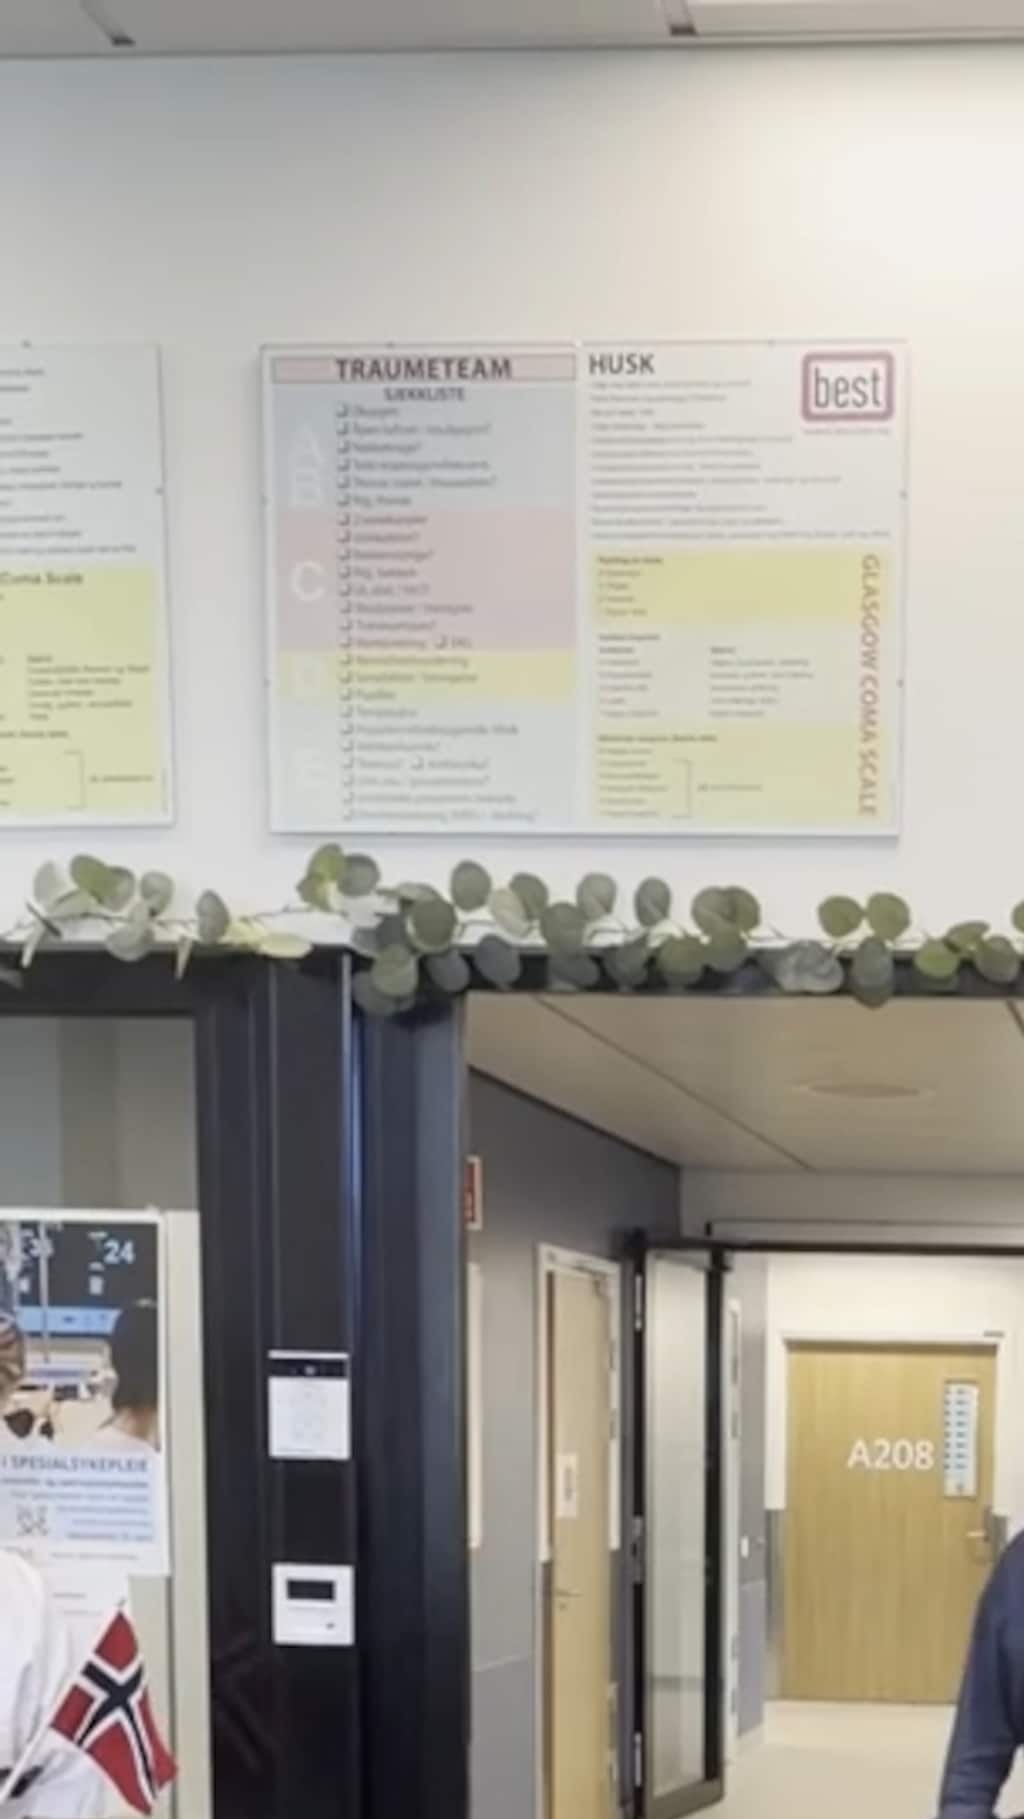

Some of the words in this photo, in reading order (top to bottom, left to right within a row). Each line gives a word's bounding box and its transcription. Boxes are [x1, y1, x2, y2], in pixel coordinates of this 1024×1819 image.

[336, 357, 514, 381] TRAUMETEAM
[588, 353, 655, 376] HUSK
[813, 366, 882, 409] best
[291, 559, 326, 601] C
[860, 553, 881, 671] GLASGOW
[858, 674, 880, 742] COMA
[857, 748, 878, 816] SCALE
[103, 1240, 136, 1264] 24
[847, 1438, 935, 1470] A208
